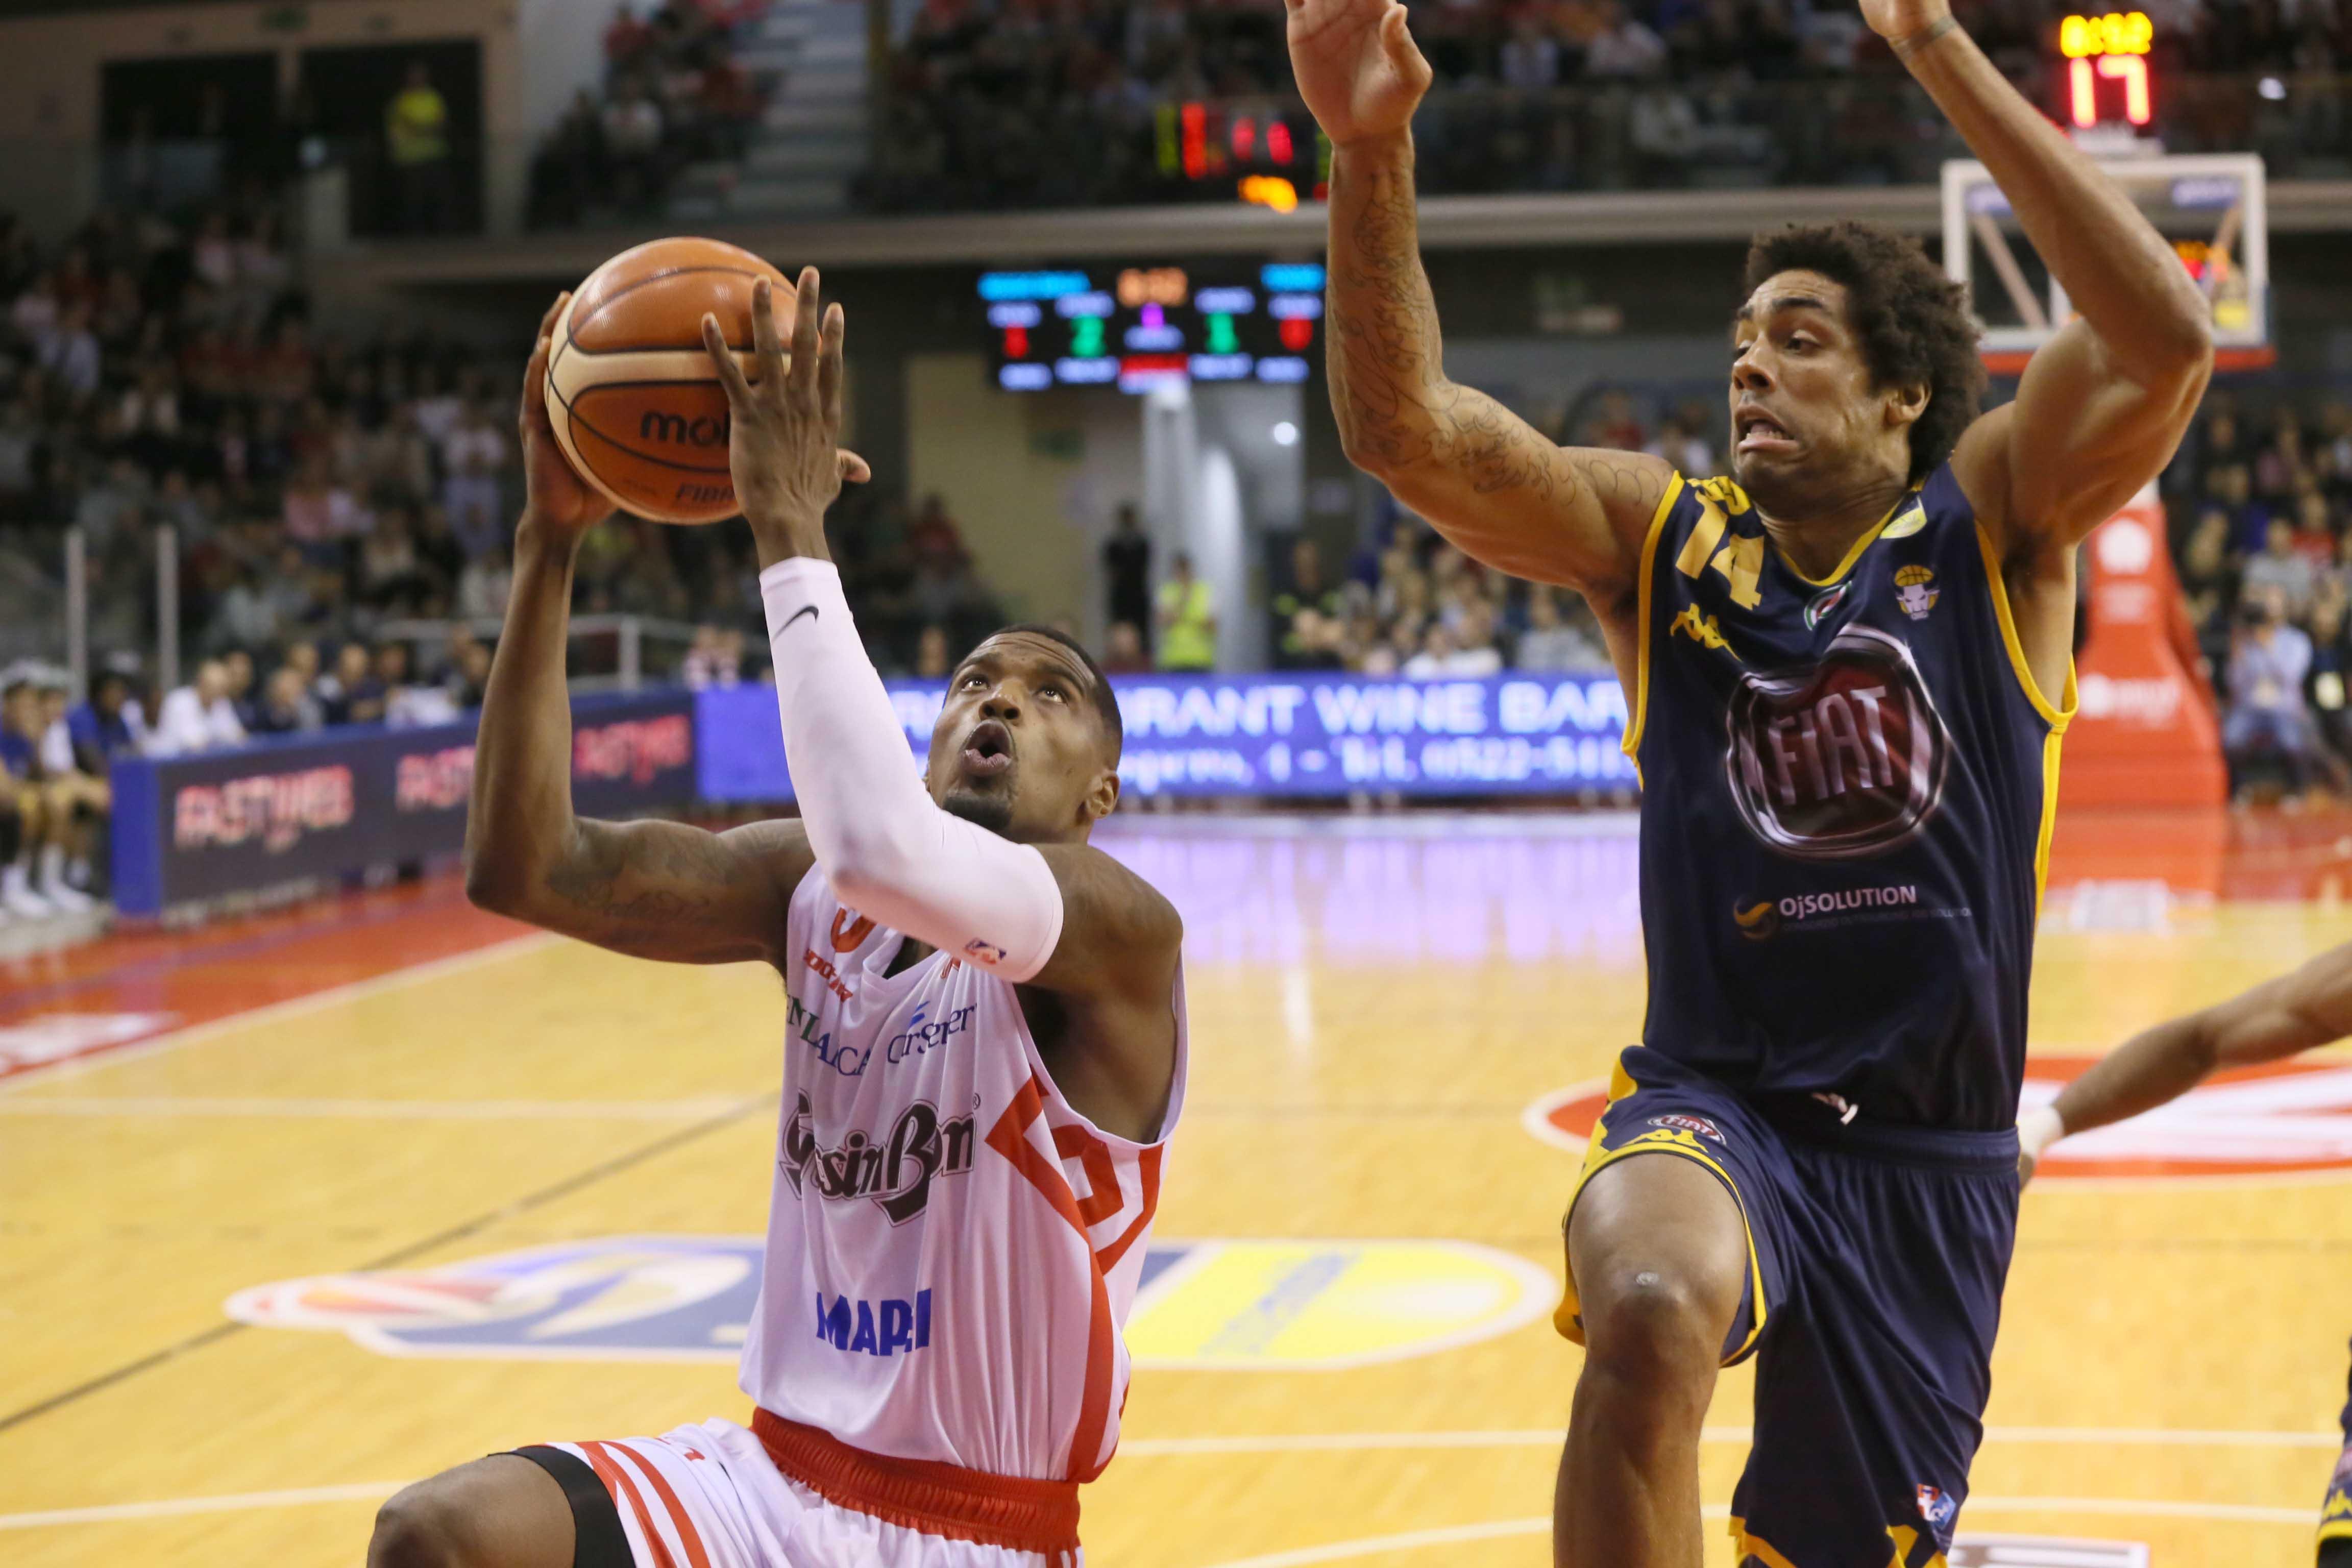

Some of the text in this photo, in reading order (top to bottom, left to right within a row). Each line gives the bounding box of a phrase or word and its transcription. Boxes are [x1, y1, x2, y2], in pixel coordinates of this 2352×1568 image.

[2070, 55, 2149, 128] 17
[641, 410, 730, 448] mol
[1312, 683, 1488, 734] WINE
[1768, 685, 1893, 805] FIAT
[817, 1288, 931, 1356] MAPI
